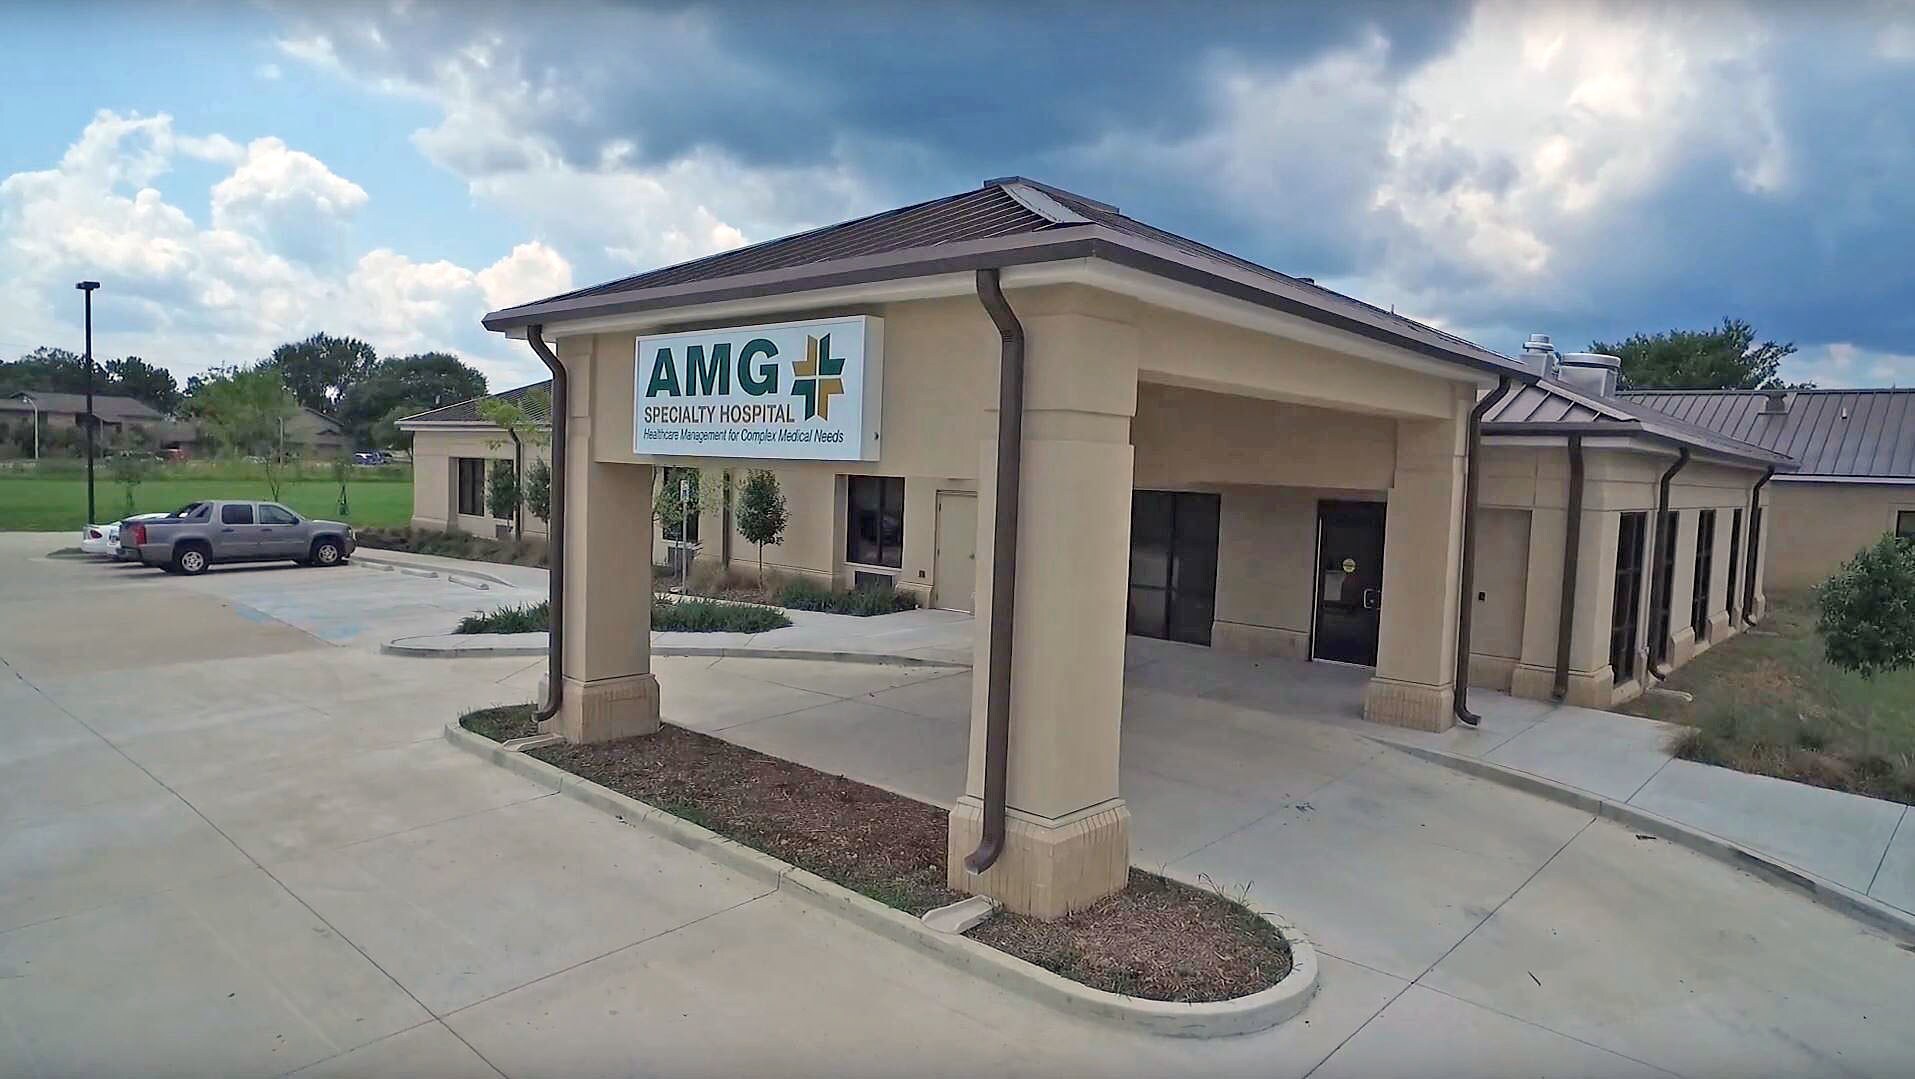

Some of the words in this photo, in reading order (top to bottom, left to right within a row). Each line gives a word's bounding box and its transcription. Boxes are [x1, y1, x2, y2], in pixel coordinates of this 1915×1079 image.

[645, 338, 779, 398] AMG
[644, 405, 716, 423] SPECIALTY
[720, 403, 795, 423] HOSPITAL
[643, 427, 679, 440] Healthcare
[680, 428, 727, 444] Management
[727, 428, 740, 441] for
[740, 428, 776, 444] Complex
[777, 428, 812, 442] Medical
[814, 428, 844, 443] Needs
